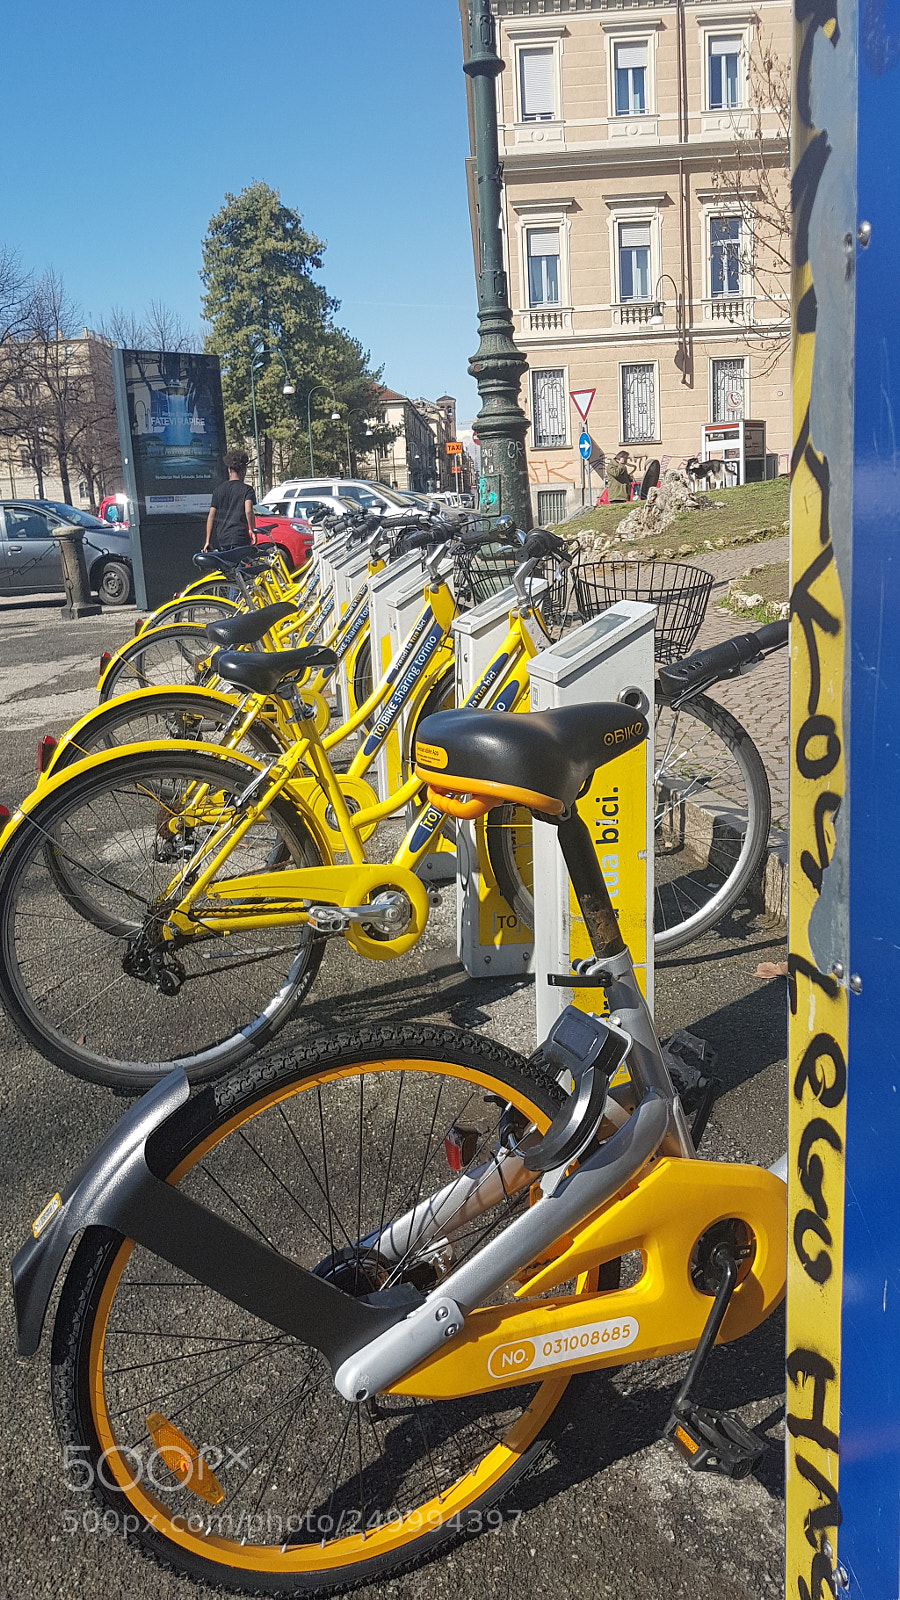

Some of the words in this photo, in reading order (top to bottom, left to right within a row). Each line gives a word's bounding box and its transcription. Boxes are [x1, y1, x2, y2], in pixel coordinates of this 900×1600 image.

[447, 444, 462, 452] TAXI
[344, 618, 364, 644] sharing
[360, 606, 370, 619] tor
[394, 648, 409, 671] Prendi
[410, 631, 420, 643] tua
[394, 666, 420, 703] sharing
[414, 635, 437, 666] torino
[474, 686, 487, 700] tua
[500, 1348, 529, 1368] NO.
[542, 1324, 631, 1357] 031008685
